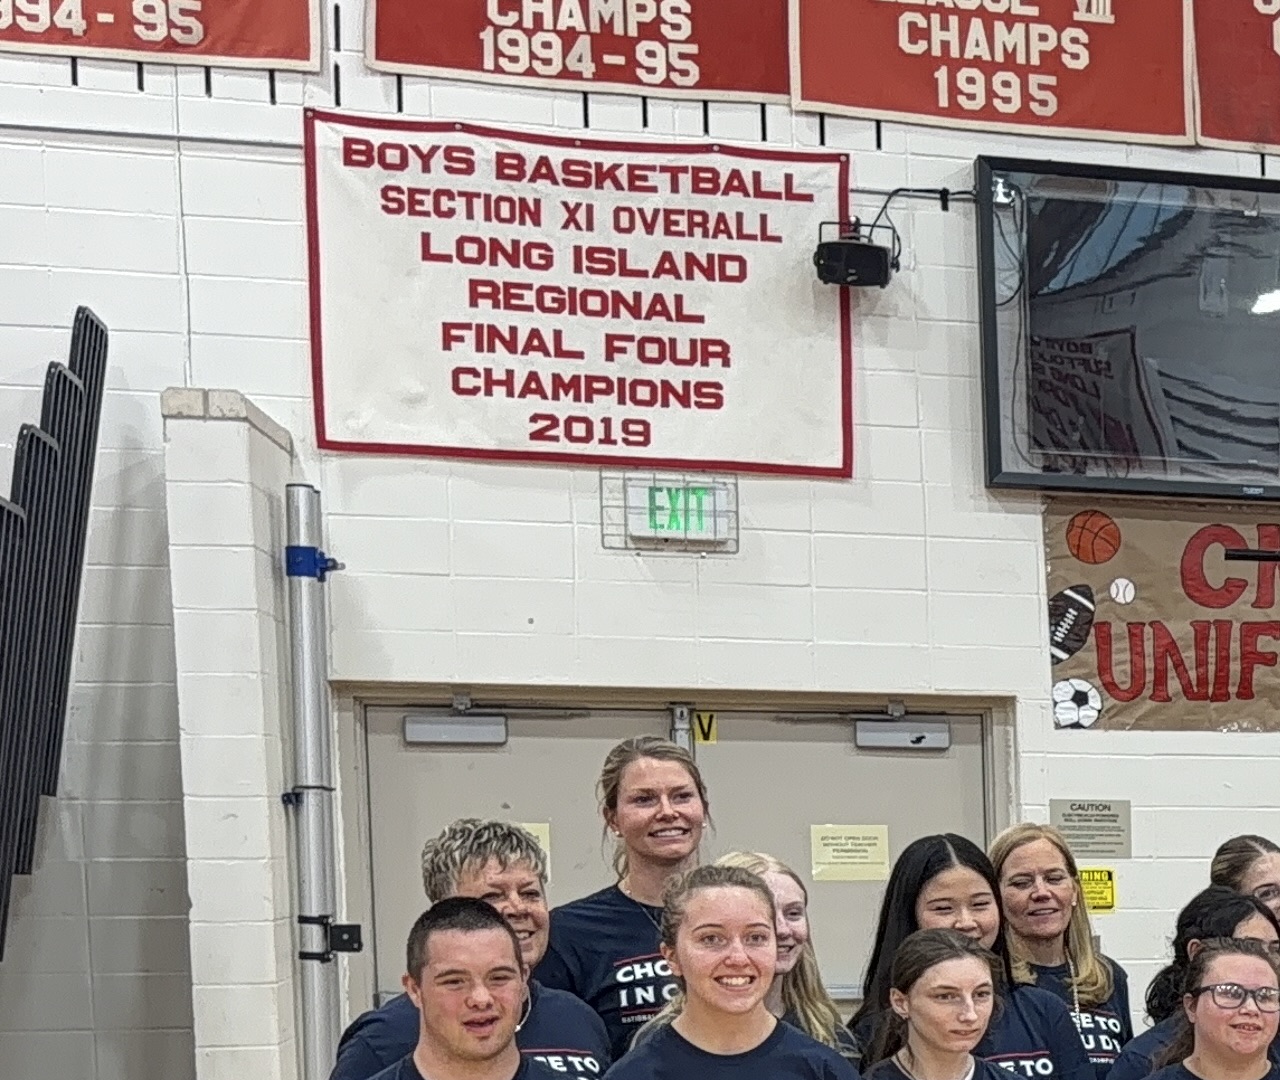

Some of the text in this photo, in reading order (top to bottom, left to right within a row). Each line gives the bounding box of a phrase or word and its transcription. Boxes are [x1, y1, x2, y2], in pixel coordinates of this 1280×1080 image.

[487, 0, 691, 45] CHAMPS
[899, 12, 1089, 69] CHAMPS
[480, 26, 699, 86] 1994-95
[934, 66, 1057, 116] 1995
[343, 137, 814, 202] BOYS BASKETBALL
[381, 185, 782, 243] SECTION XI OVERALL
[421, 232, 747, 283] LONG ISLAND
[469, 279, 704, 323] REGIONAL
[442, 322, 730, 367] FINAL FOUR
[452, 367, 723, 409] CHAMPIONS
[529, 413, 650, 447] 2019
[648, 486, 708, 531] EXIT
[1070, 803, 1111, 812] CAUTION
